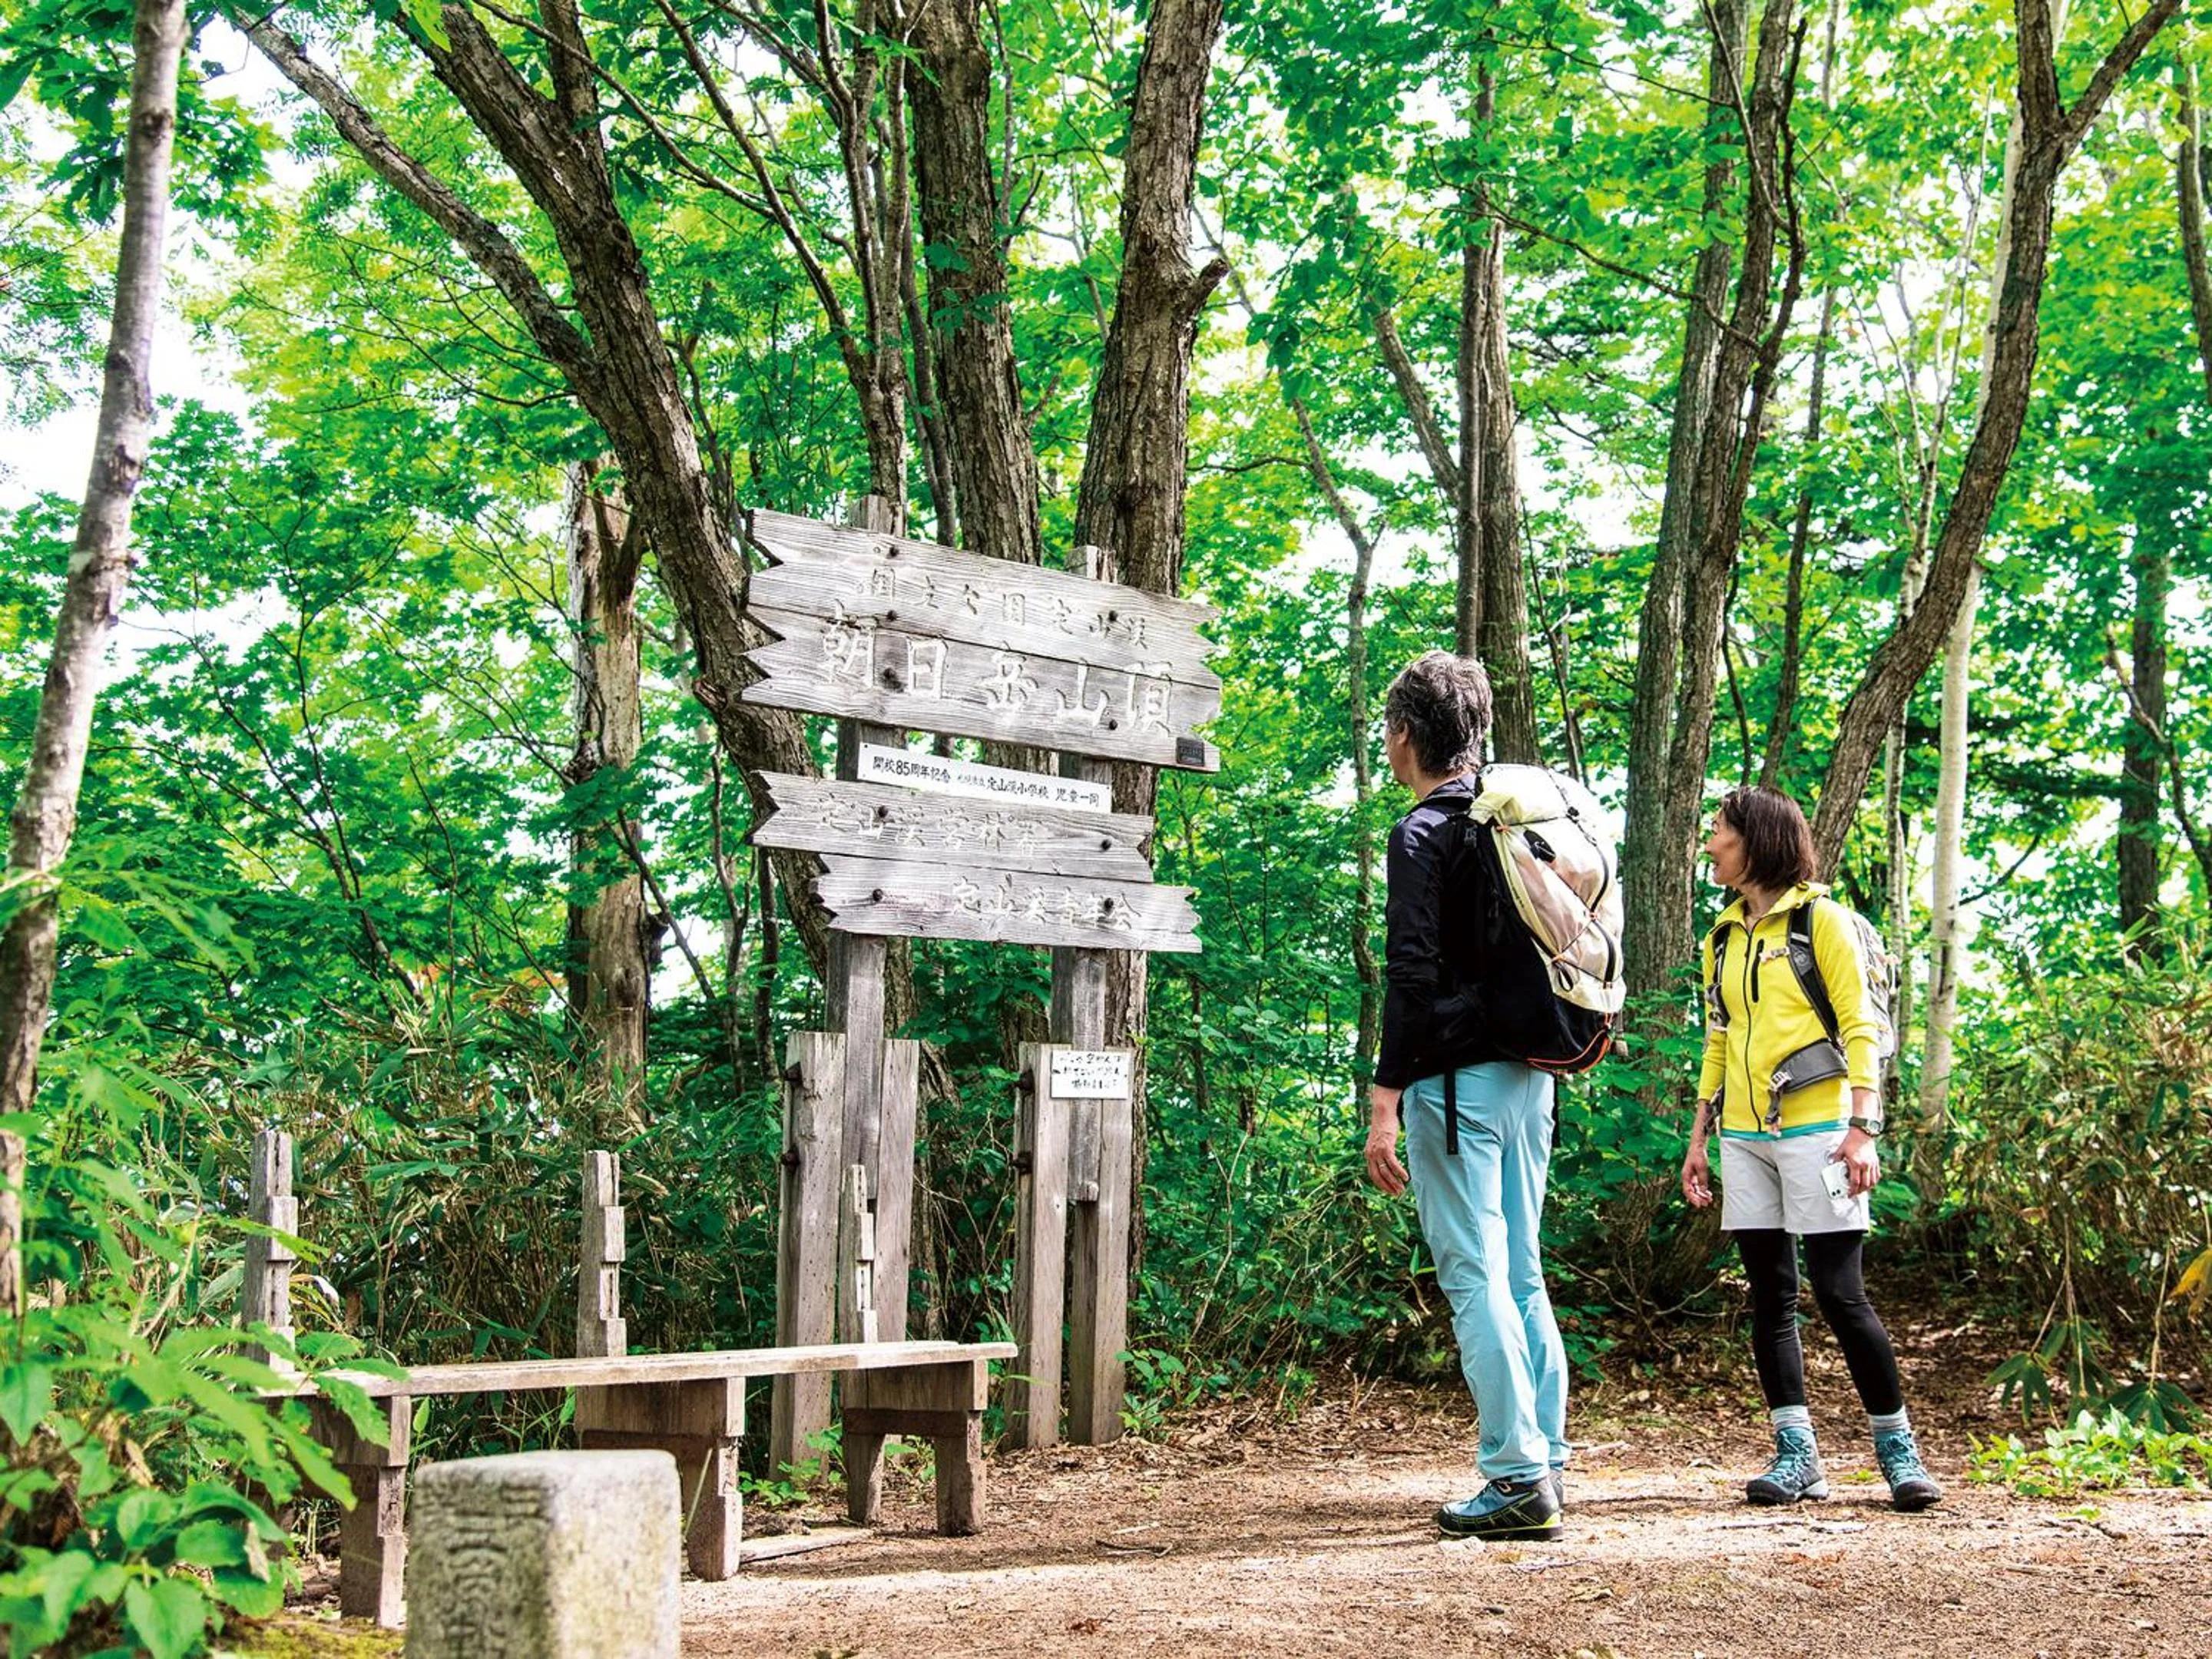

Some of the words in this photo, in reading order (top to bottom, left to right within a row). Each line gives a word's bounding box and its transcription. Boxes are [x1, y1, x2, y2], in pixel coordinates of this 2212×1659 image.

[820, 598, 1174, 737] 朝日岳山頂
[872, 756, 952, 784] 開校85周年記念
